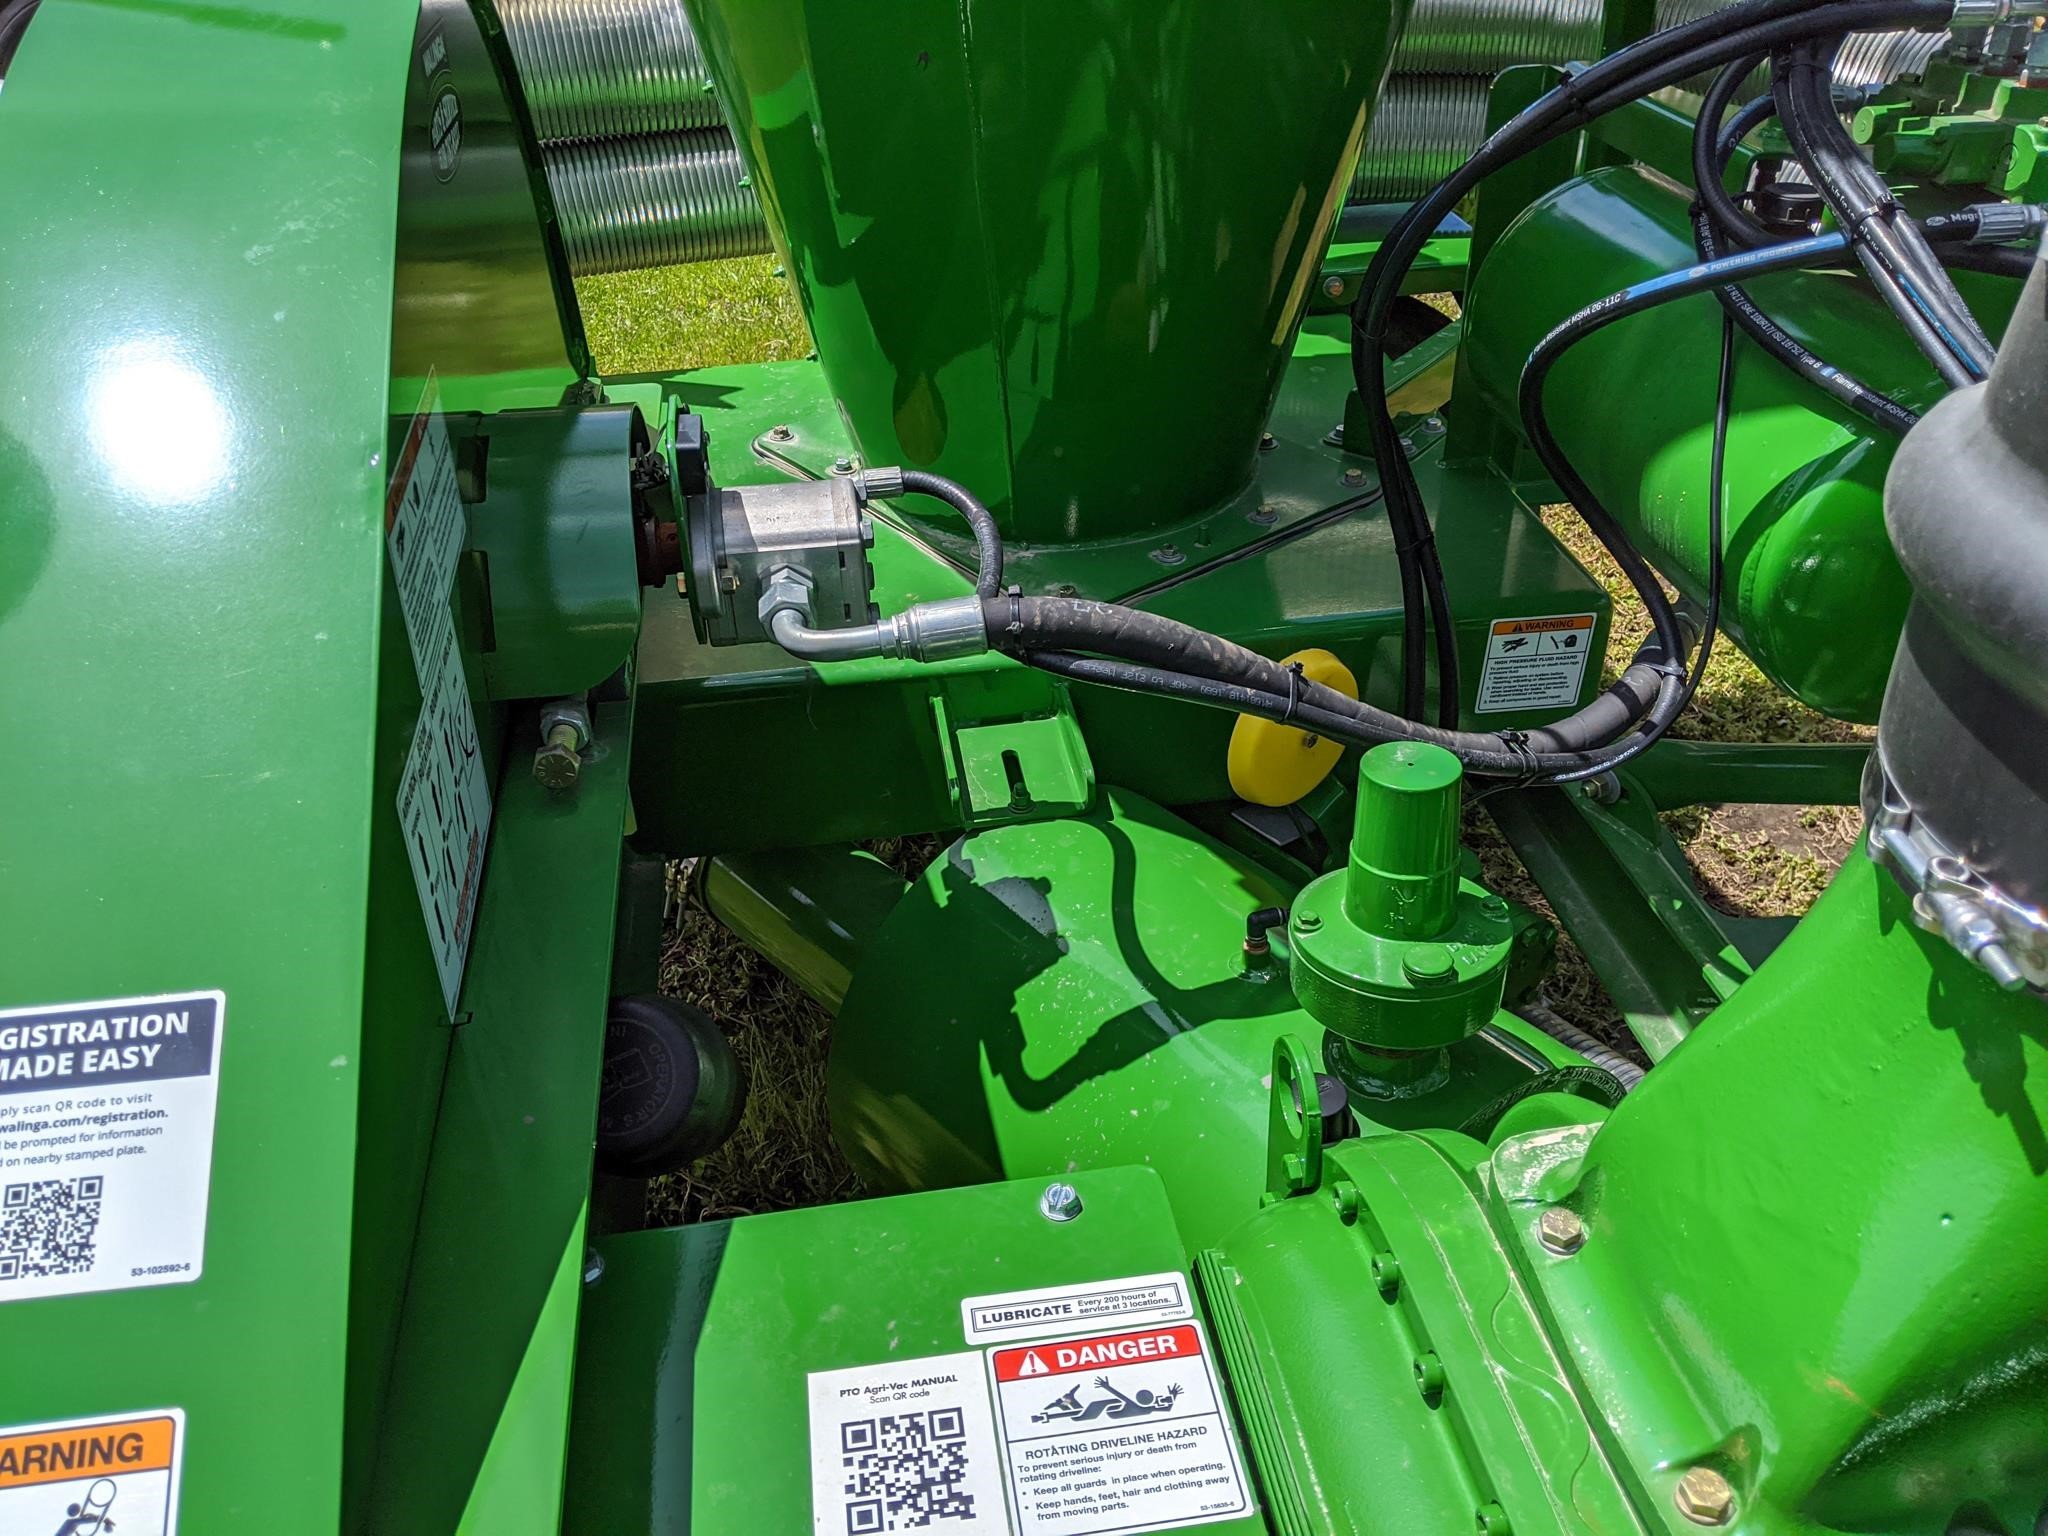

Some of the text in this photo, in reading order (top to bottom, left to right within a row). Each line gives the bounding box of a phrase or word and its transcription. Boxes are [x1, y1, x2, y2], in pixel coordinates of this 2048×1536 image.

[1710, 254, 1756, 271] POWERING
[1571, 307, 1591, 324] MSHA
[1591, 293, 1621, 313] 2G-11C
[1831, 370, 1854, 391] Flame
[1884, 398, 1908, 420] MSHA
[1524, 619, 1574, 630] WARNING
[82, 1043, 162, 1073] EASY
[23, 1104, 50, 1114] scan
[55, 1100, 72, 1112] QR
[77, 1097, 105, 1109] code
[110, 1096, 122, 1105] to
[126, 1093, 152, 1104] visit
[4, 1125, 162, 1149] be prompted for information
[6, 1144, 146, 1167] on nearby stamped plate.
[131, 1262, 190, 1276] 53-102592-6
[982, 1291, 1157, 1324] LUBRICATE Every 200 hours of
[1079, 1304, 1110, 1315] service
[1122, 1301, 1128, 1309] 3
[1129, 1297, 1171, 1308] locations.
[1055, 1334, 1178, 1370] DANGER
[840, 1374, 958, 1397] PTO Agri-Vac MANUAL
[869, 1388, 930, 1404] Scan QR code
[1090, 1433, 1154, 1450] DRIVELINE
[1156, 1426, 1208, 1440] HAZARD
[0, 1432, 144, 1477] ARNING
[1017, 1464, 1030, 1472] To
[1032, 1459, 1068, 1472] prevent
[1069, 1454, 1104, 1465] serious
[1105, 1450, 1132, 1461] injury
[1146, 1444, 1172, 1454] death
[1174, 1441, 1197, 1450] from
[1019, 1465, 1101, 1483] rotating driveline:
[1033, 1462, 1226, 1496] Keep all guards in place when operating.
[1035, 1476, 1230, 1510] Keep hands, feet, hair and clothing away
[1037, 1500, 1129, 1520] from moving parts.
